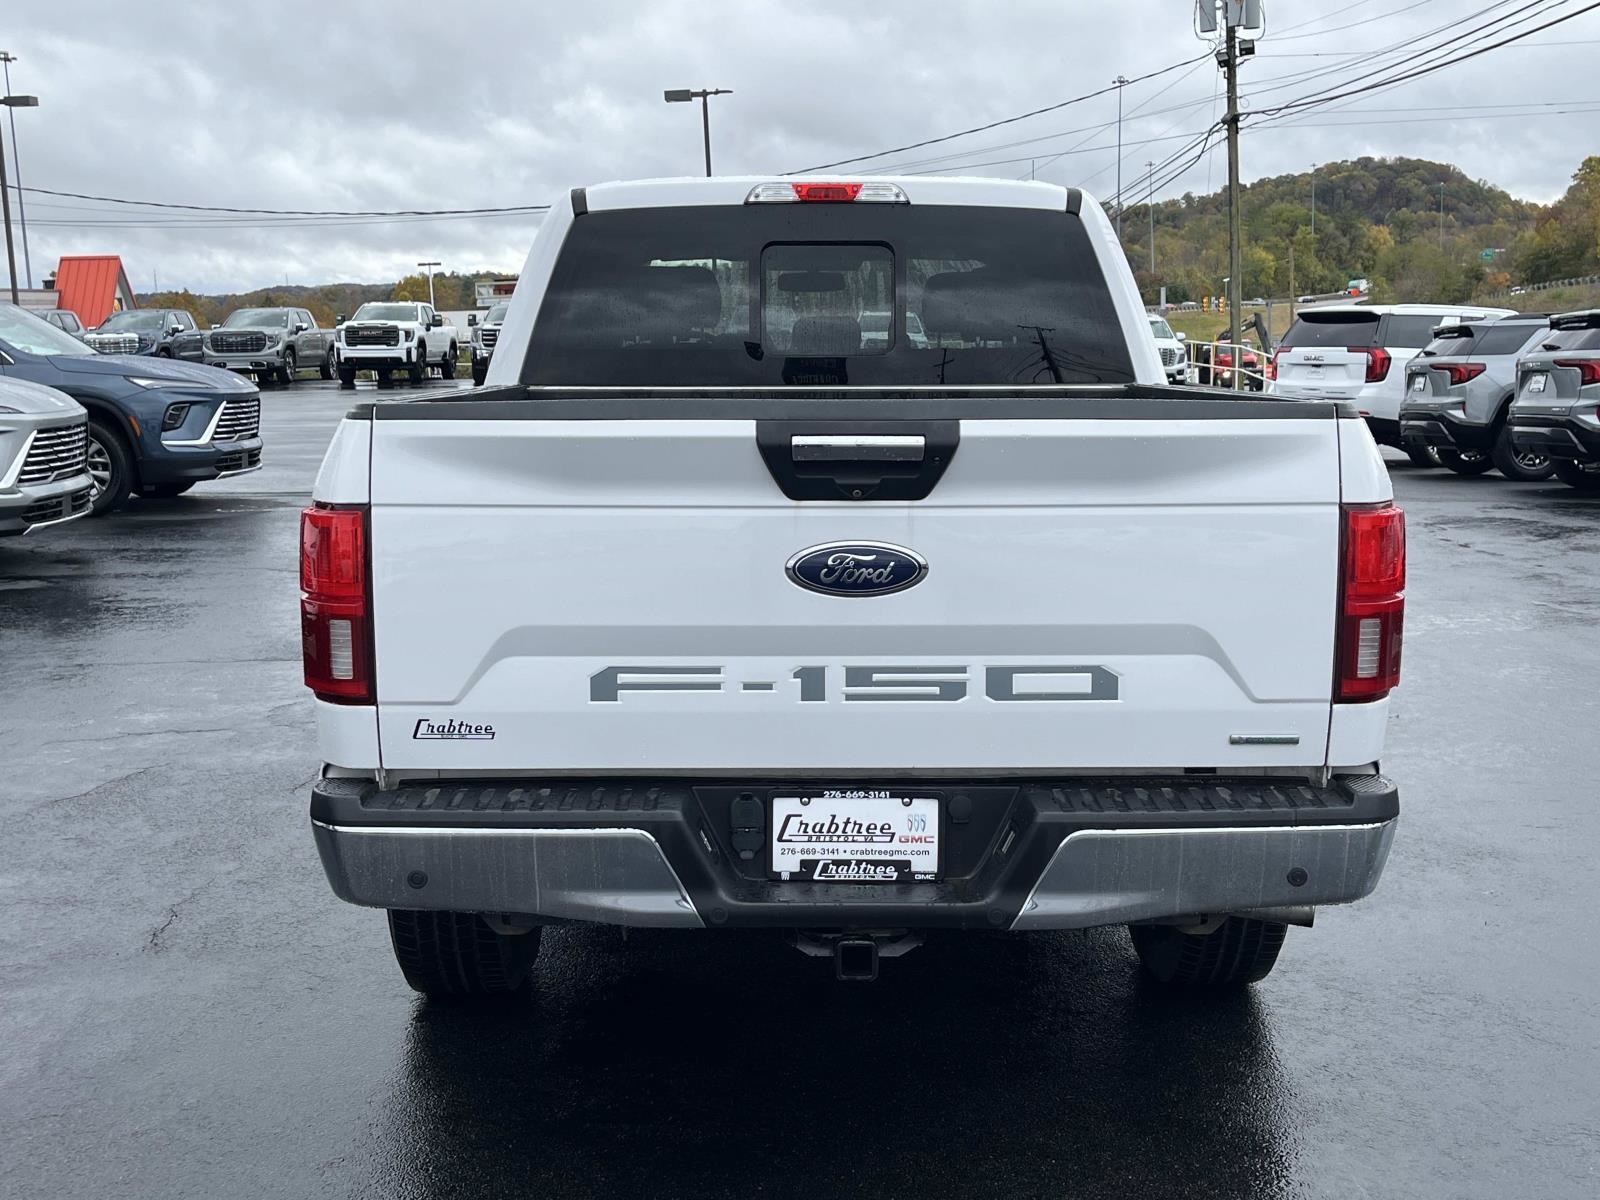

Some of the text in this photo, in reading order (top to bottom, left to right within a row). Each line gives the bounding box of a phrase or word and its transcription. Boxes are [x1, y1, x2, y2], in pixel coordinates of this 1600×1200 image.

[819, 553, 896, 583] Ford
[589, 666, 1120, 702] F-150
[412, 718, 496, 740] Crabtree
[823, 790, 890, 799] 276-669-3141
[776, 813, 896, 843] Crabtree
[898, 835, 936, 844] GMC
[780, 847, 930, 857] 276-669-3141 crabtreegmc.com
[812, 859, 898, 881] Crabtree
